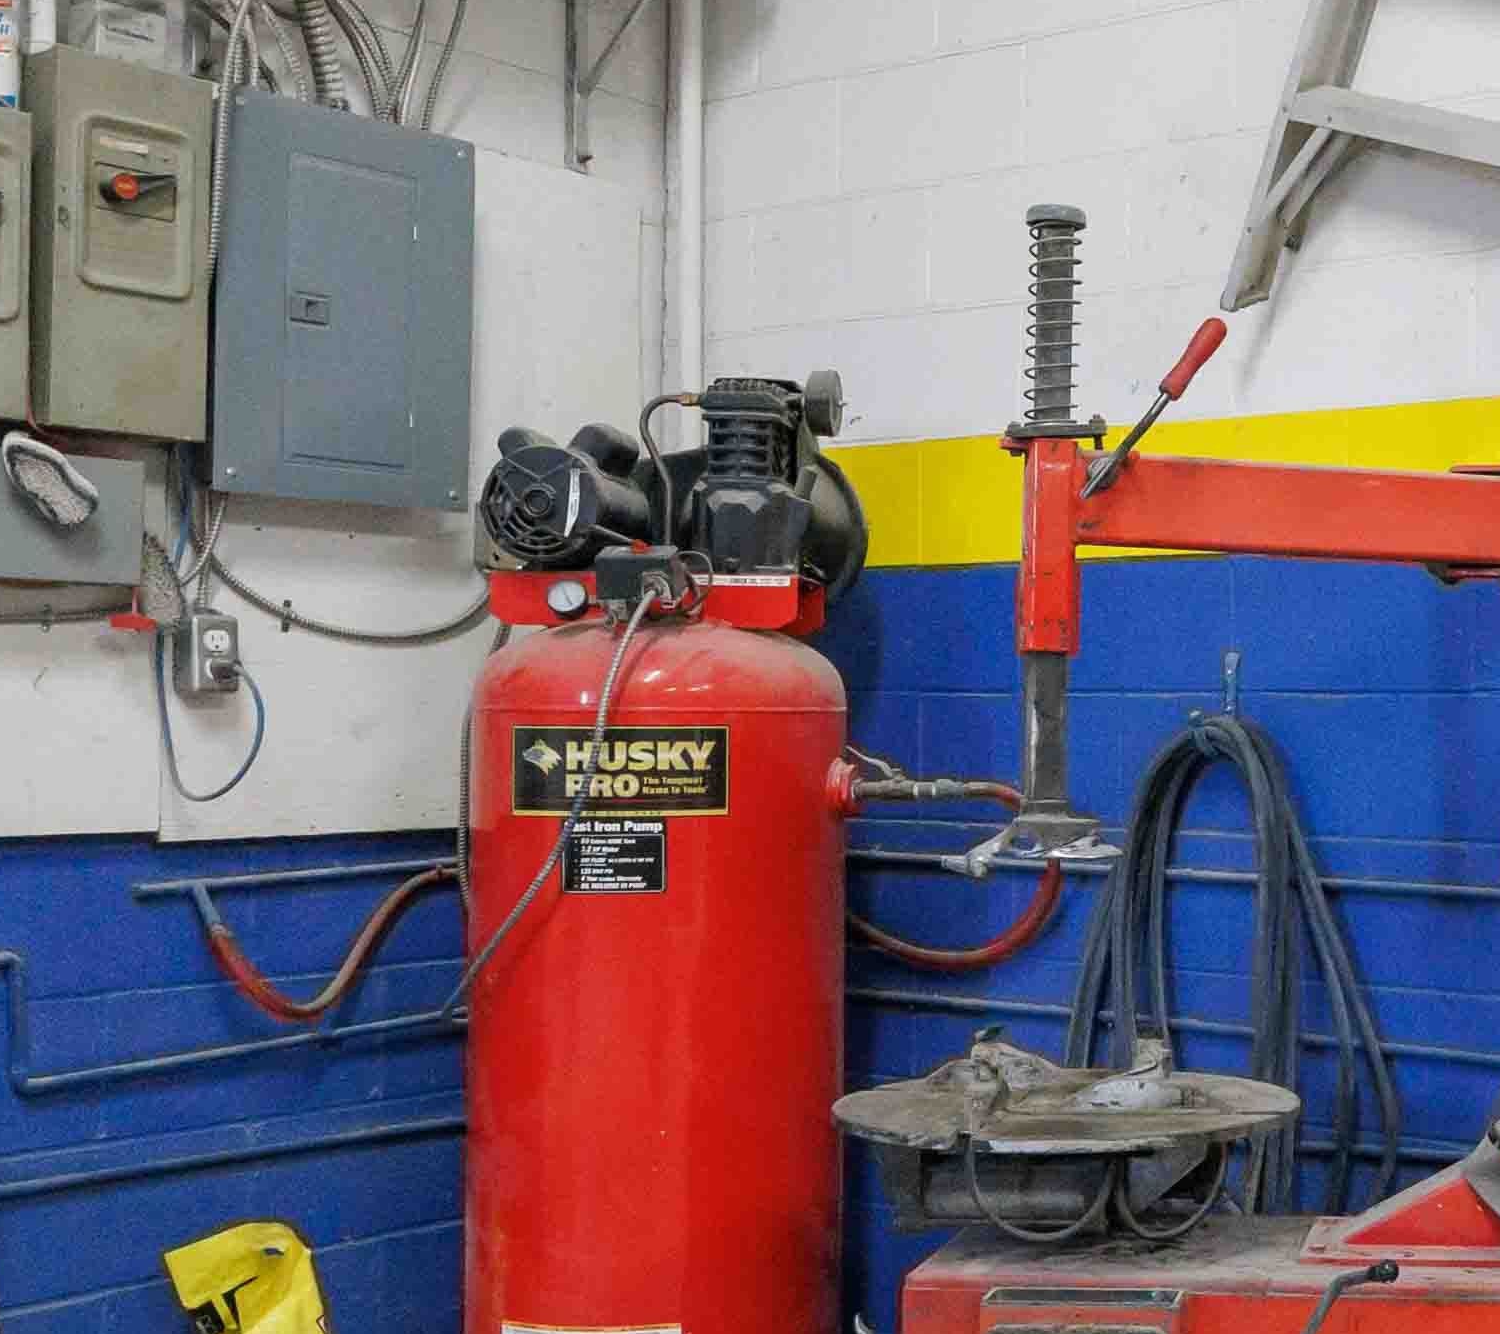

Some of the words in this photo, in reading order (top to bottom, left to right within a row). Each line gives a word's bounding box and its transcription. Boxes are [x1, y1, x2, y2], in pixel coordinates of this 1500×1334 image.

[565, 741, 715, 771] HUSKY
[565, 773, 640, 797] PRO
[564, 820, 592, 833] ast
[594, 820, 621, 833] Iron
[623, 820, 664, 834] Pump
